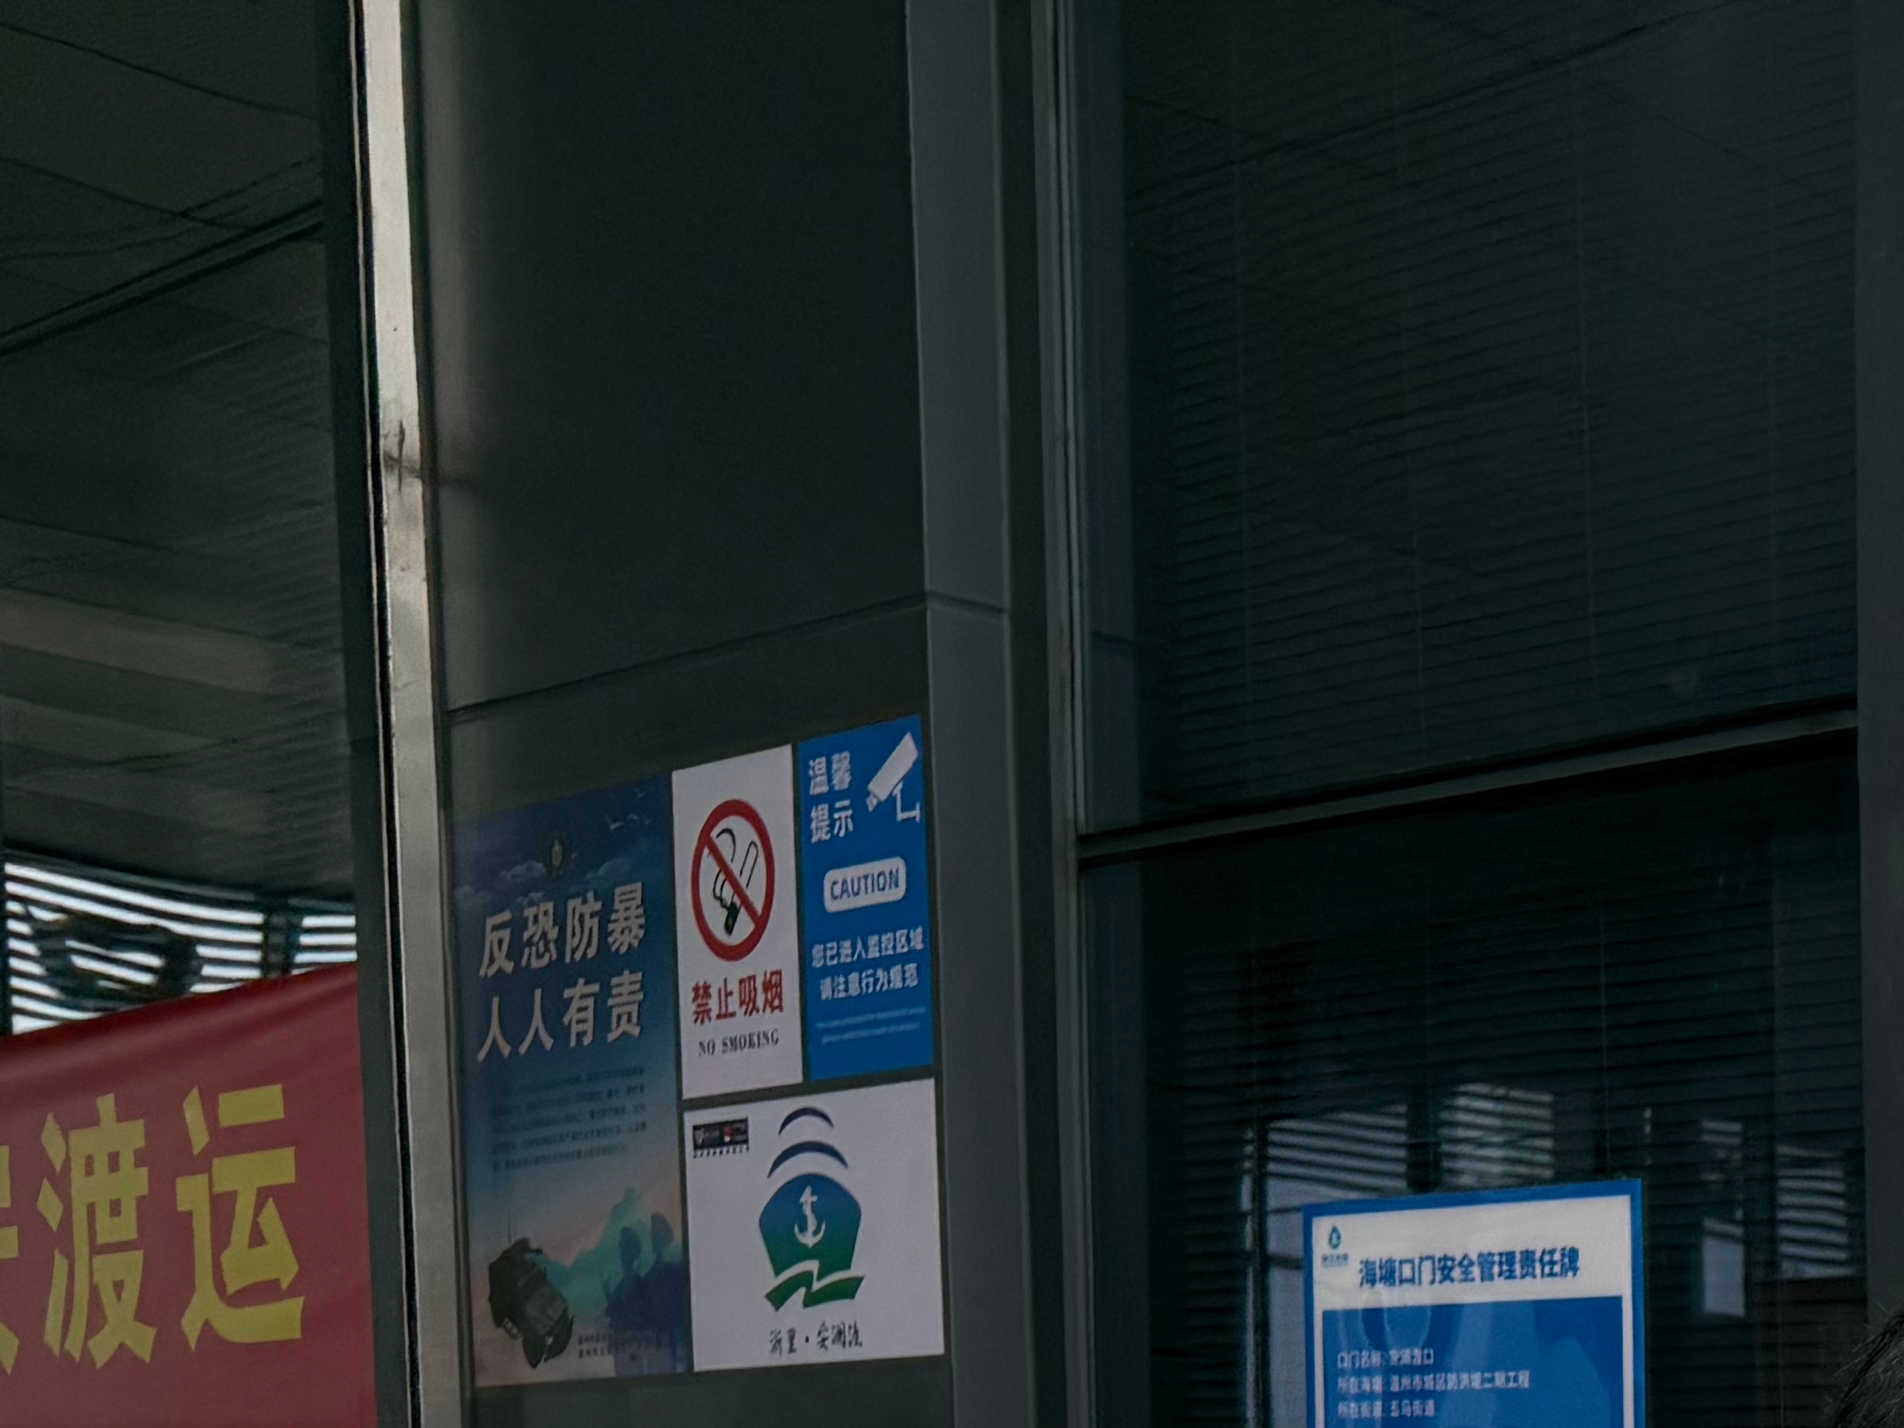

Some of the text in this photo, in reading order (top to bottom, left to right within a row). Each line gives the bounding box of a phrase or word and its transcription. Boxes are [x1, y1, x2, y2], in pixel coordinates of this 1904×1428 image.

[808, 750, 852, 796] 温馨
[810, 798, 854, 844] 提示
[830, 867, 900, 901] CAUTION
[478, 881, 647, 979] 反恐防暴
[812, 926, 924, 968] 您已进入监控区域
[690, 968, 785, 1026] 禁止吸烟
[820, 963, 919, 1001] 请注意行为规范
[476, 970, 645, 1064] 人人有责
[698, 1029, 780, 1058] NO SMOKING
[1358, 1246, 1580, 1289] 海塘口门安全管理责任牌
